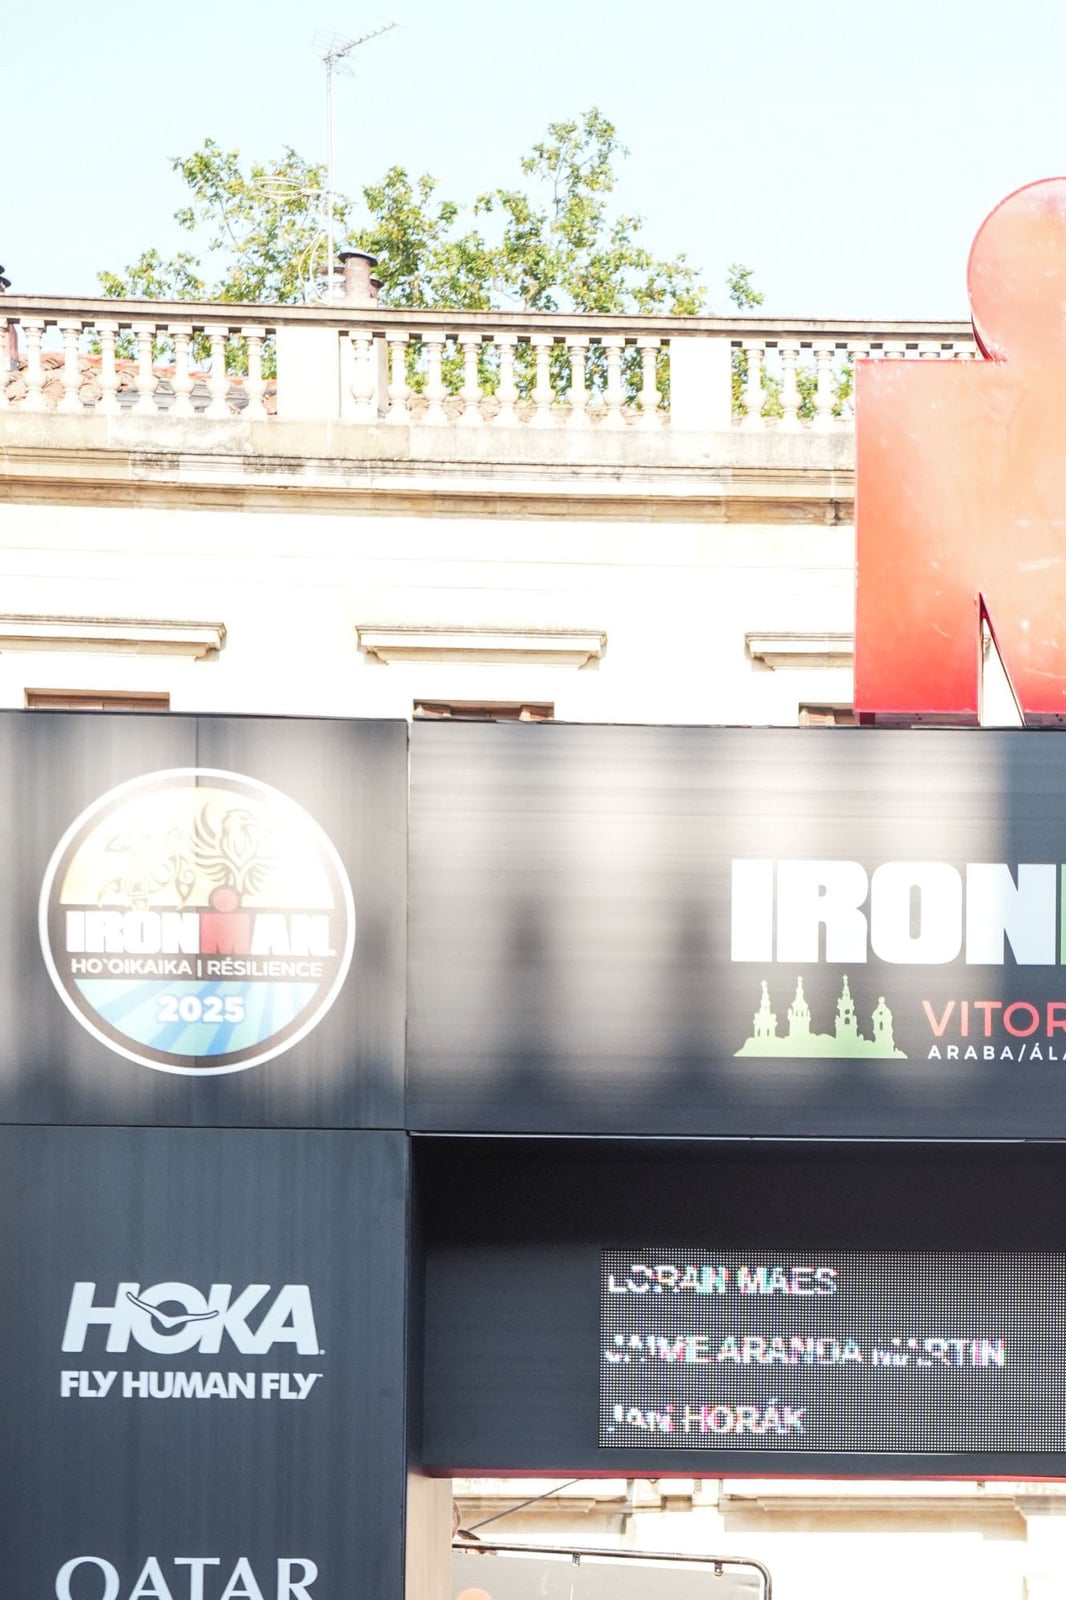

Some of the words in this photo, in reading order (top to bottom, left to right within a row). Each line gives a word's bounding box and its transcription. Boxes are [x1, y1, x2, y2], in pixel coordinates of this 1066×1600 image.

[66, 909, 330, 956] IRONMAN
[207, 956, 323, 977] RÉSILIENCE
[157, 996, 246, 1024] 2025
[737, 1267, 838, 1295] MAES
[62, 1282, 320, 1355] HOKA
[716, 1335, 863, 1365] ARANDA
[61, 1371, 117, 1398] FLY
[123, 1371, 256, 1399] HUMAN
[262, 1373, 318, 1400] FLY
[683, 1398, 807, 1434] HORÁK
